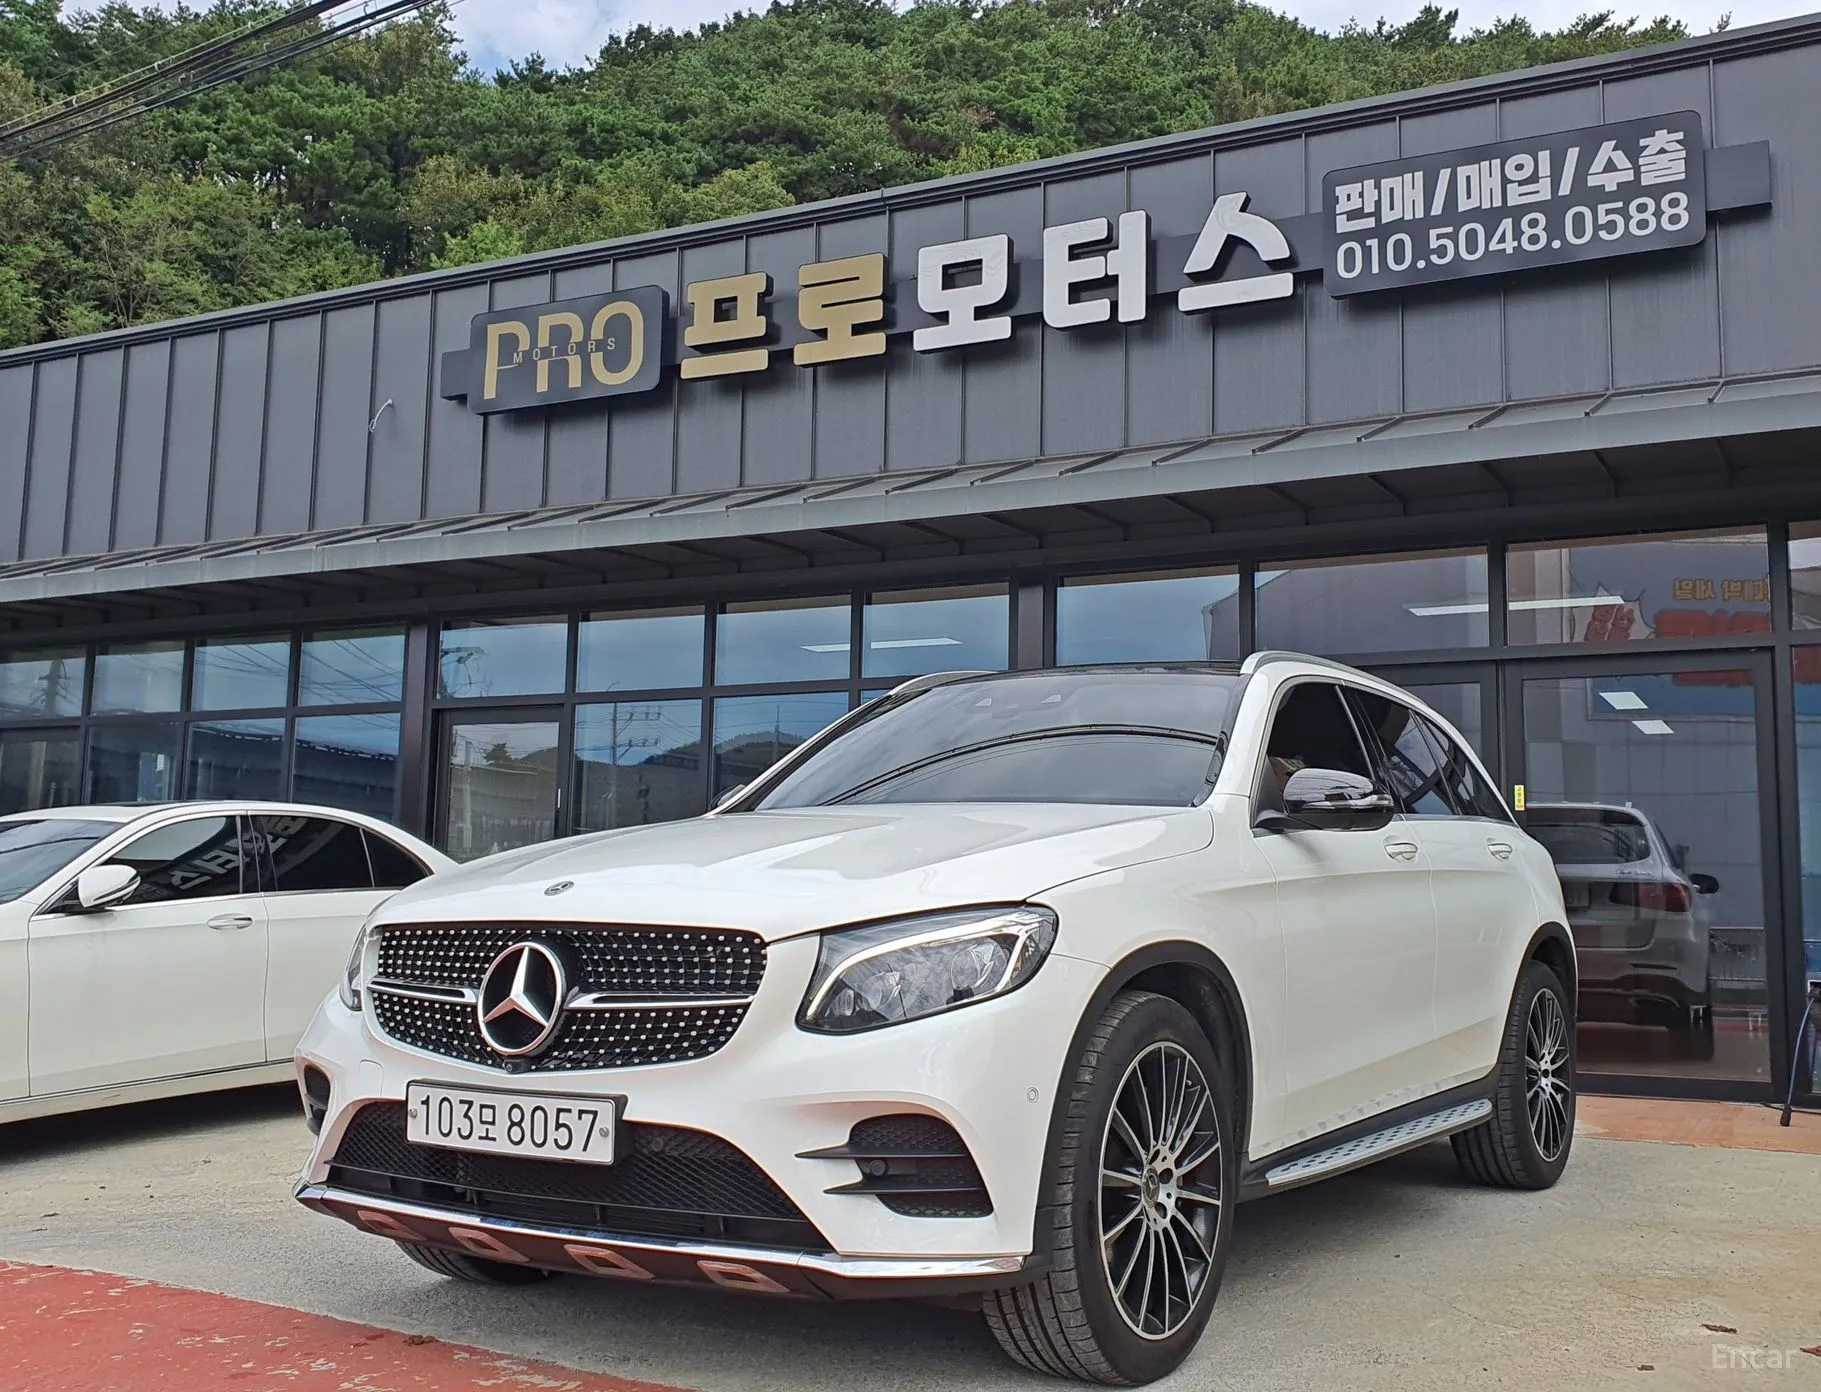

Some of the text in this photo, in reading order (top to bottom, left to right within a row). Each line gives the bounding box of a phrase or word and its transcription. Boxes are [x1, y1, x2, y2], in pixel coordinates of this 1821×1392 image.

[1335, 129, 1687, 234] 판매/매입/수출
[1336, 191, 1690, 279] 010.5048.0588
[483, 300, 644, 400] PRO
[512, 338, 616, 364] MOTORS
